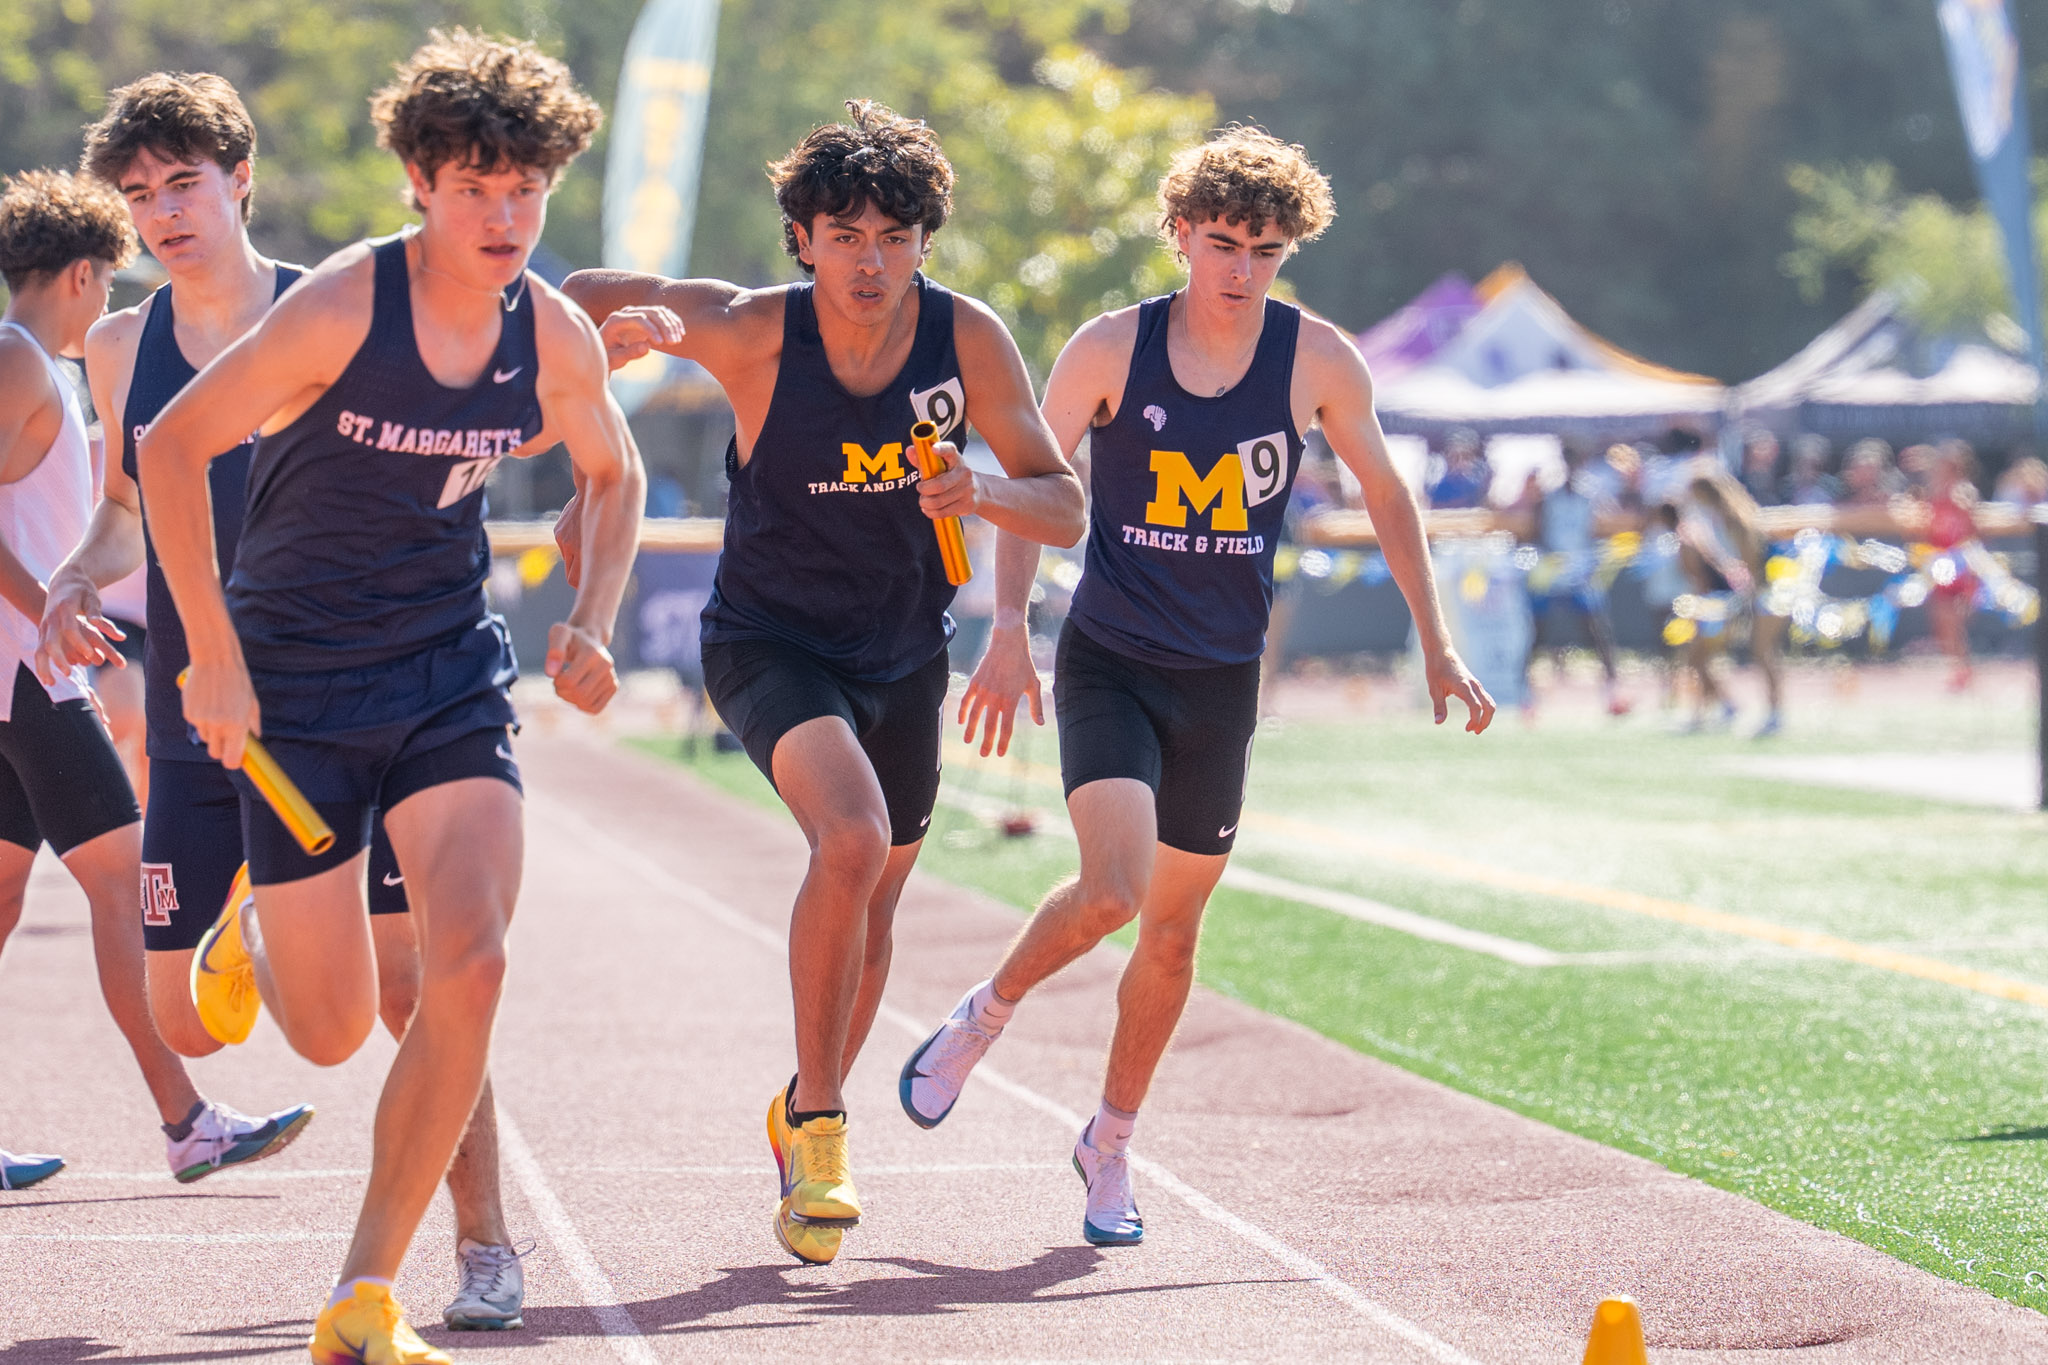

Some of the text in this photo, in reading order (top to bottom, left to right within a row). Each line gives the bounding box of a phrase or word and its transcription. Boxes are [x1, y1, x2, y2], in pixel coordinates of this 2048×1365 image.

[927, 390, 956, 440] 9
[808, 470, 921, 495] TRACK AND FIE
[842, 442, 905, 483] M
[1251, 440, 1280, 499] 9
[1145, 450, 1249, 532] M
[1122, 524, 1265, 555] TRACK & FIELD
